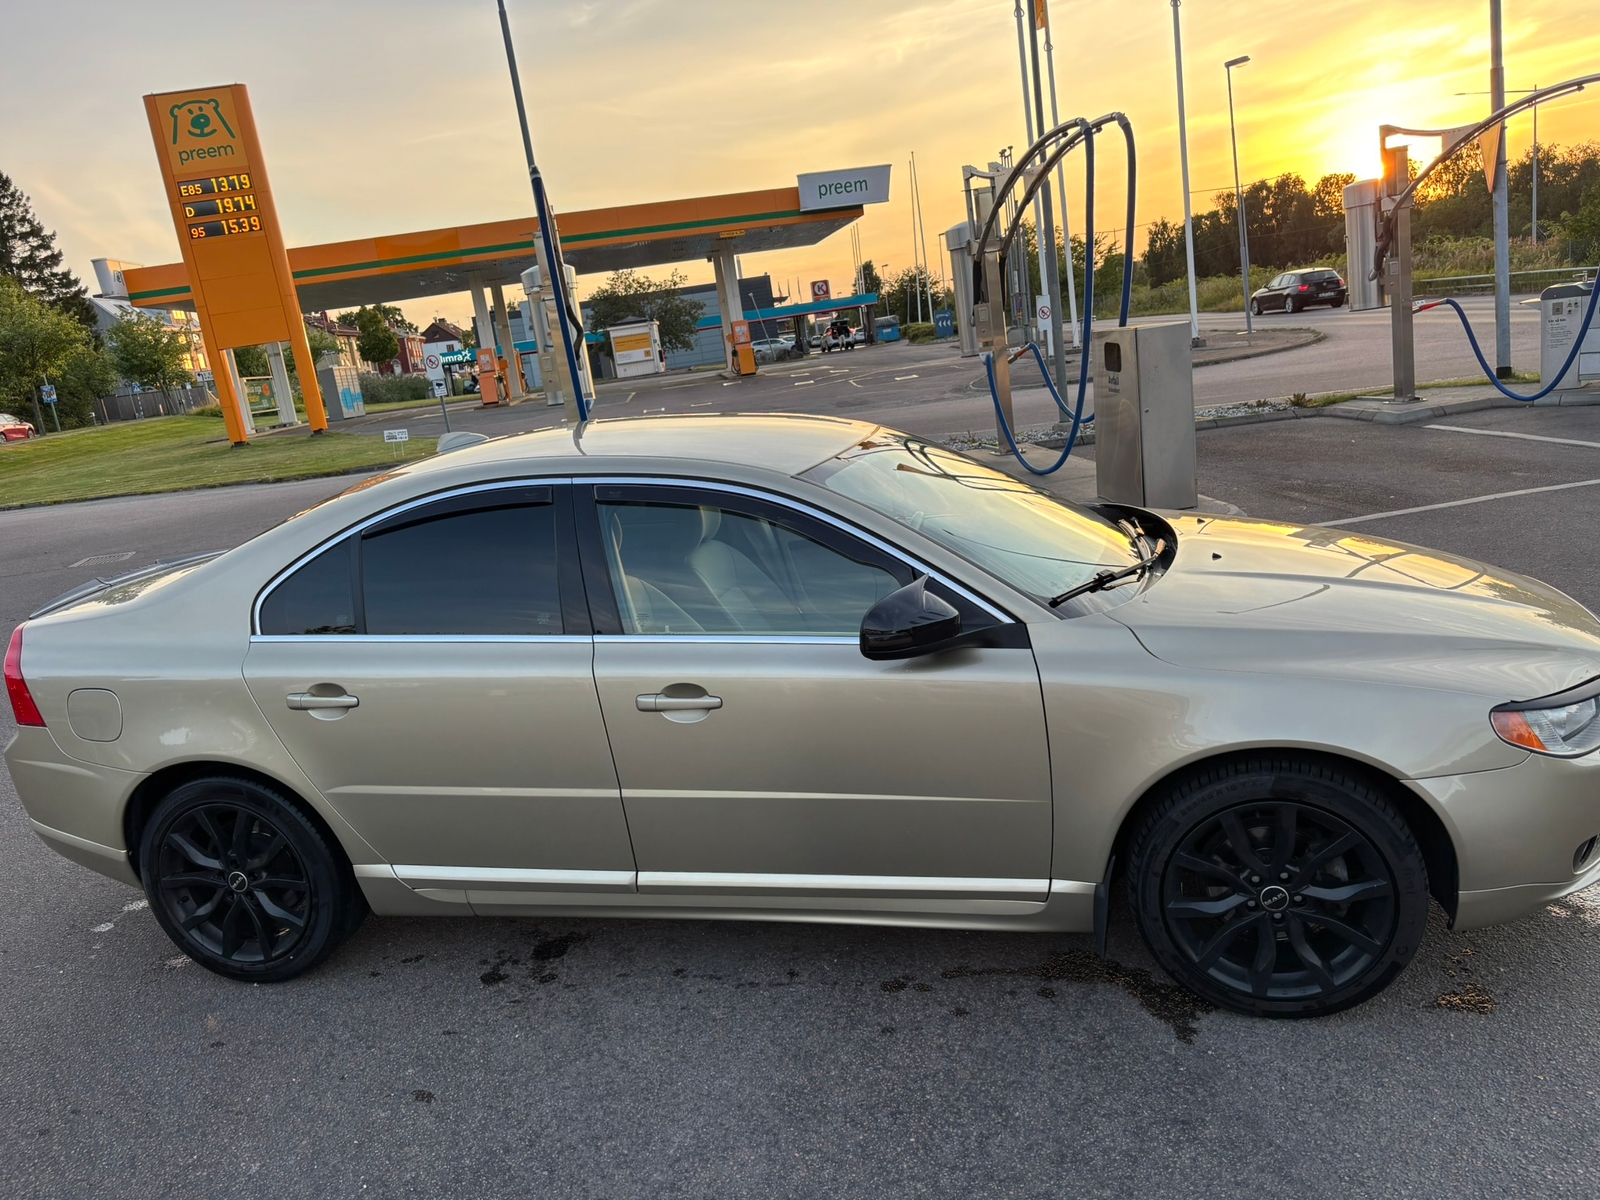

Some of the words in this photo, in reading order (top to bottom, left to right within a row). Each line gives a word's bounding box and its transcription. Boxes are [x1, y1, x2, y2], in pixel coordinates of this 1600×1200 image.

[178, 144, 235, 166] preem
[180, 183, 202, 197] E85
[210, 174, 250, 193] 13.79
[818, 179, 868, 200] preem
[185, 206, 195, 218] D
[215, 195, 256, 213] 19.74
[191, 226, 206, 238] 95
[221, 216, 260, 235] 15.39
[1264, 892, 1286, 906] MAK
